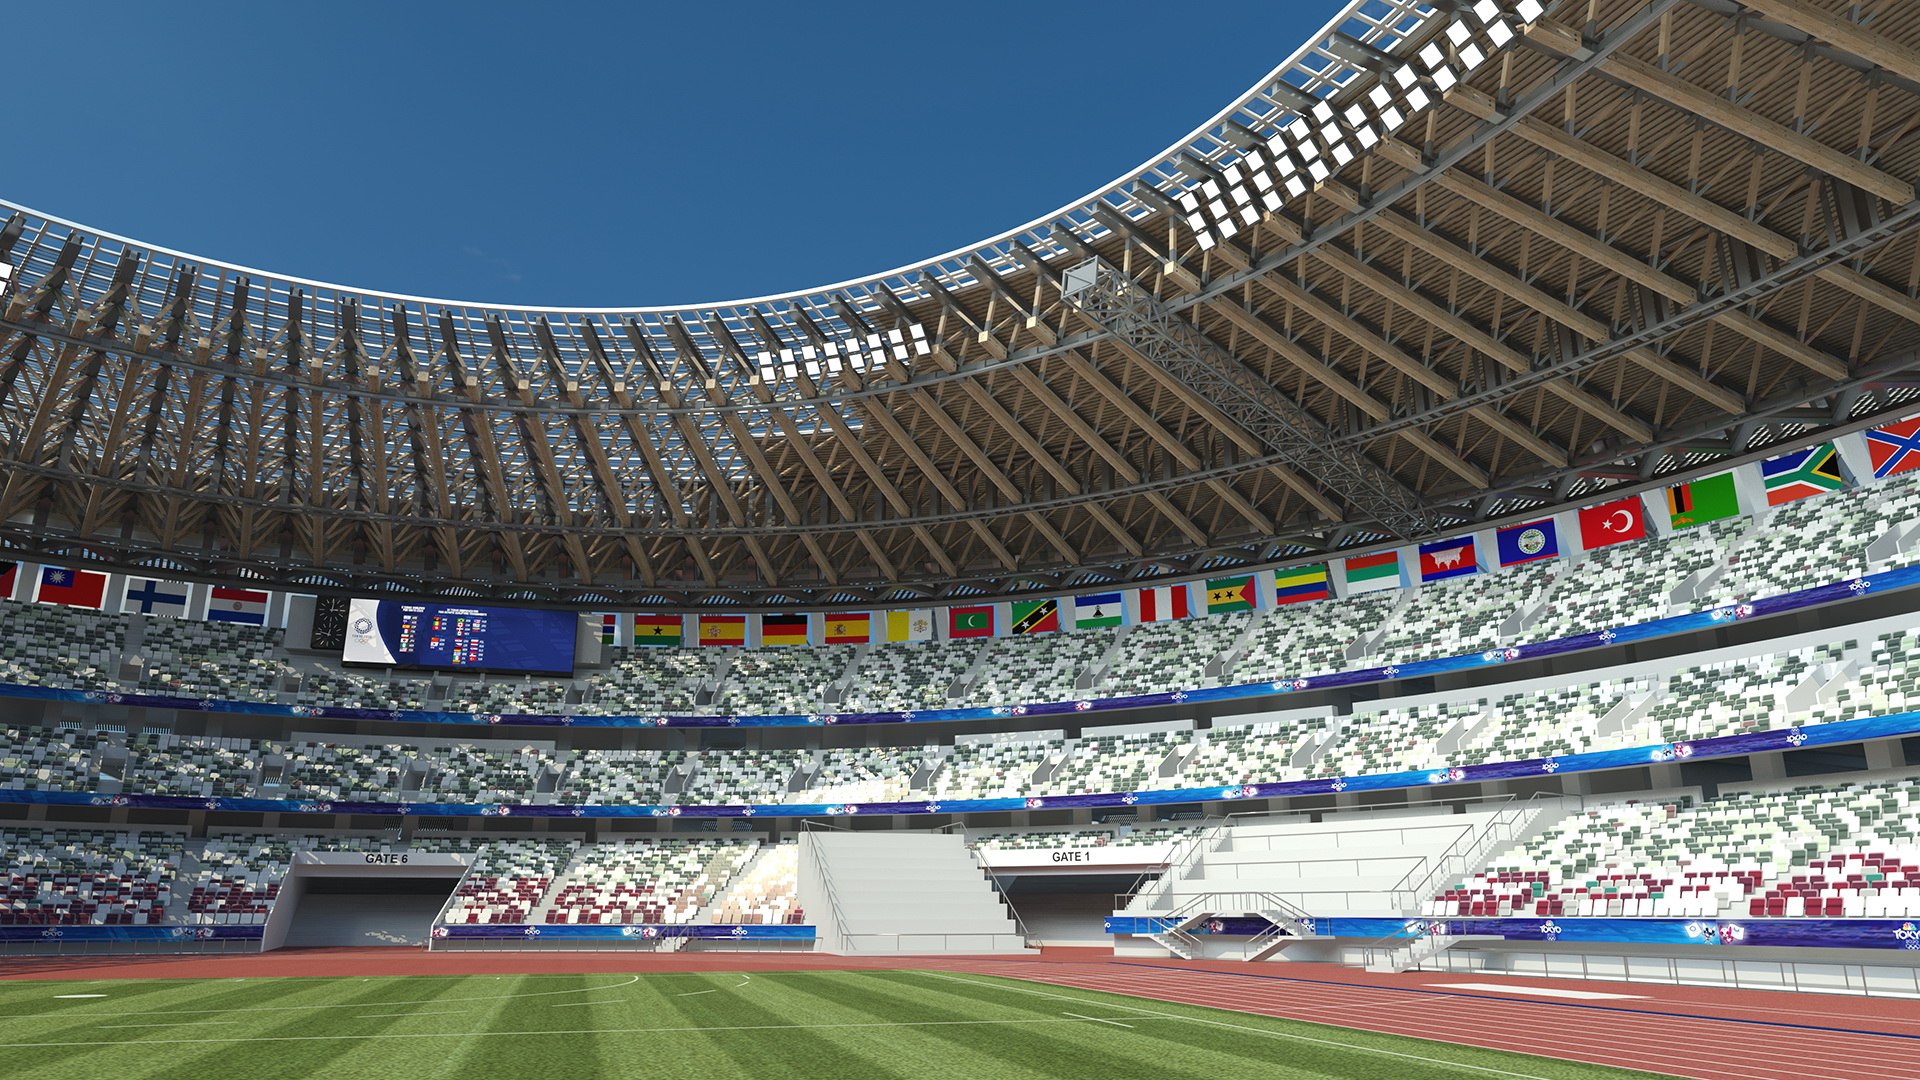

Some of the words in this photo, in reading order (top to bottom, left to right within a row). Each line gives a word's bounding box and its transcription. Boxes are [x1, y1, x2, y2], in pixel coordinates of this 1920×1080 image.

[1849, 581, 1870, 590] TOKYO
[365, 853, 398, 863] GATE
[401, 854, 408, 863] 6
[1052, 851, 1082, 862] GATE
[1085, 851, 1090, 861] 1
[1540, 924, 1561, 933] TOKYO
